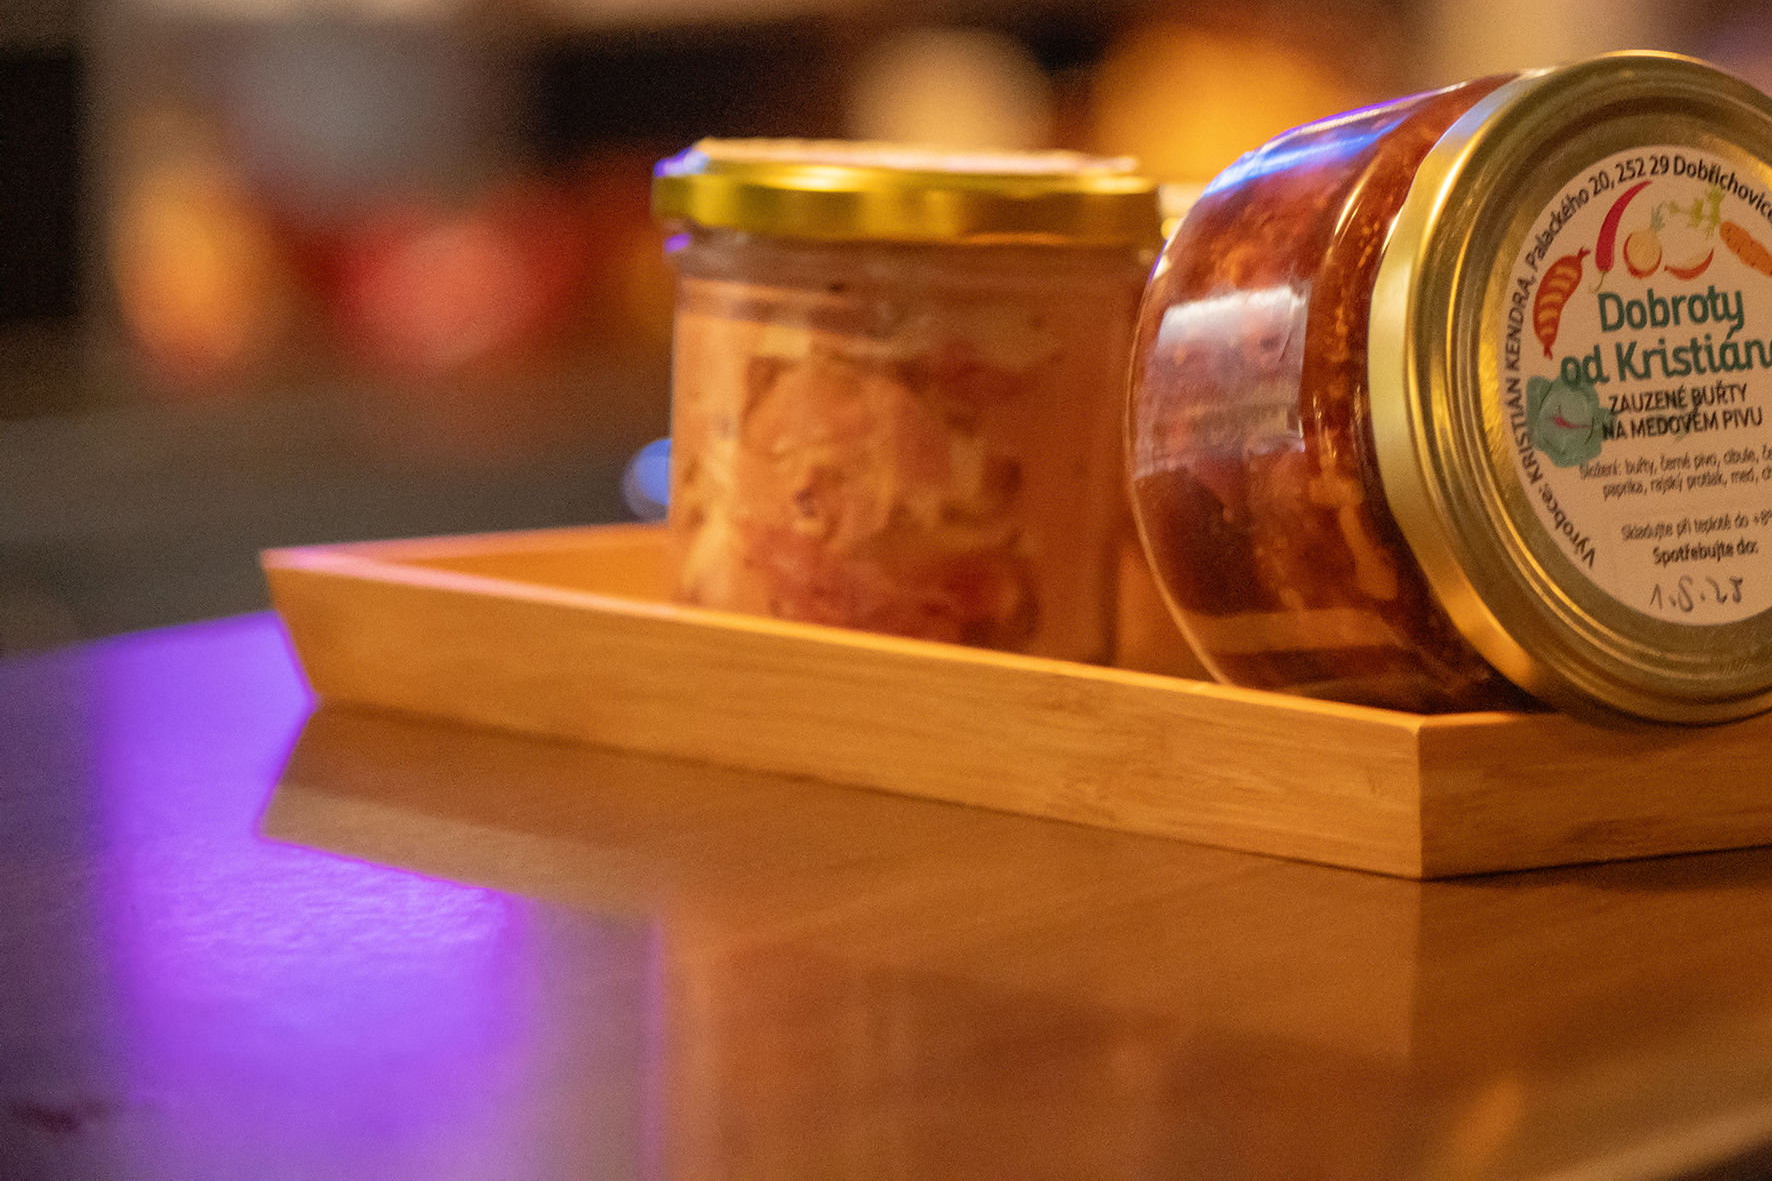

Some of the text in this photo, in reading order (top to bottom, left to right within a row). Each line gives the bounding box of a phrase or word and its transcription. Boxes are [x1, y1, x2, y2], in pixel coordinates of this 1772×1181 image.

[1616, 157, 1646, 184] 252
[1649, 154, 1669, 175] 29
[1589, 170, 1615, 198] 20,
[1525, 188, 1590, 272] Palackého
[1504, 275, 1536, 371] KENDRA,
[1598, 285, 1745, 333] Dobroty
[1560, 344, 1610, 392] od
[1608, 380, 1748, 417] ZAUZENÉ BUŘTY
[1602, 405, 1763, 443] NA MEDOVÉM PIVU
[1538, 483, 1596, 569] Výrobce:
[1652, 537, 1735, 569] Spotřebujte
